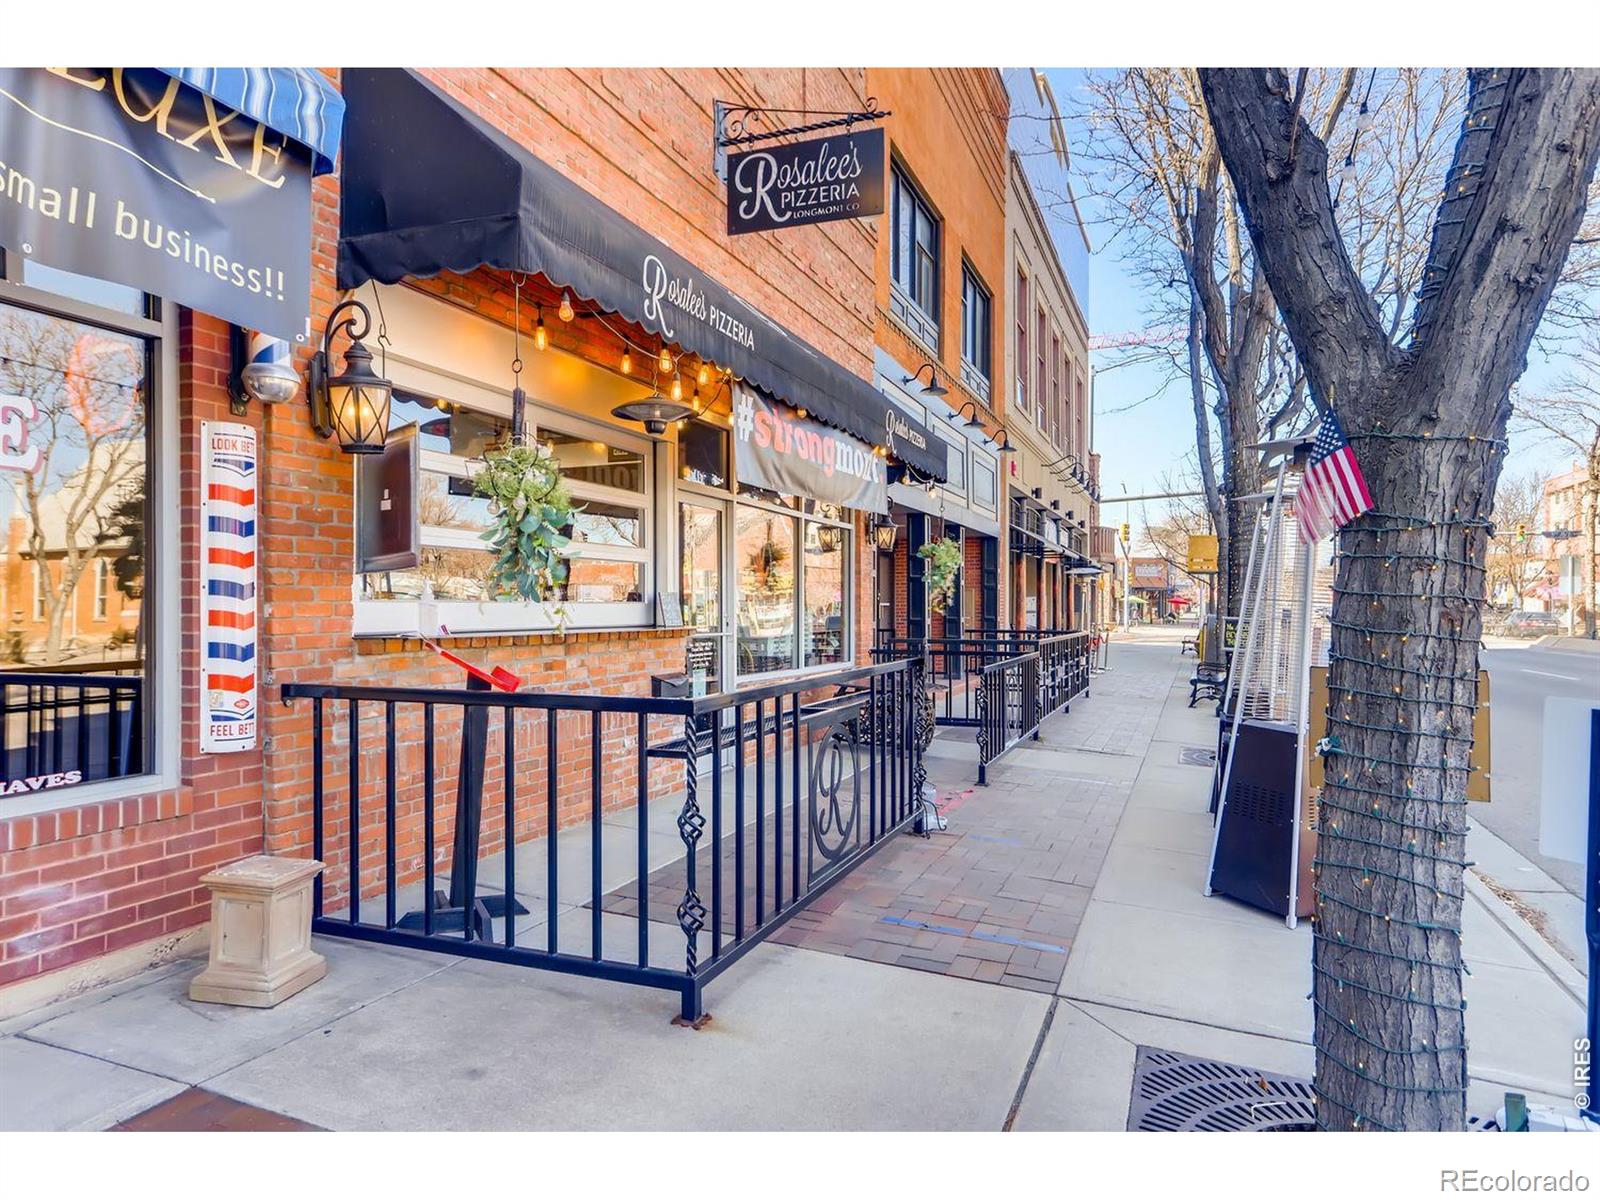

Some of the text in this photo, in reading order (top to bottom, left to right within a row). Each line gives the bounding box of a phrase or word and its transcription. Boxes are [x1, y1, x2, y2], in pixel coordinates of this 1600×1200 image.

[735, 141, 863, 223] Rosalee's
[781, 182, 860, 209] PIZZERIA
[115, 200, 284, 301] business!!
[643, 255, 755, 351] Rosalee's PIZZERIA
[211, 438, 238, 451] LOOK
[210, 724, 234, 736] FEEL
